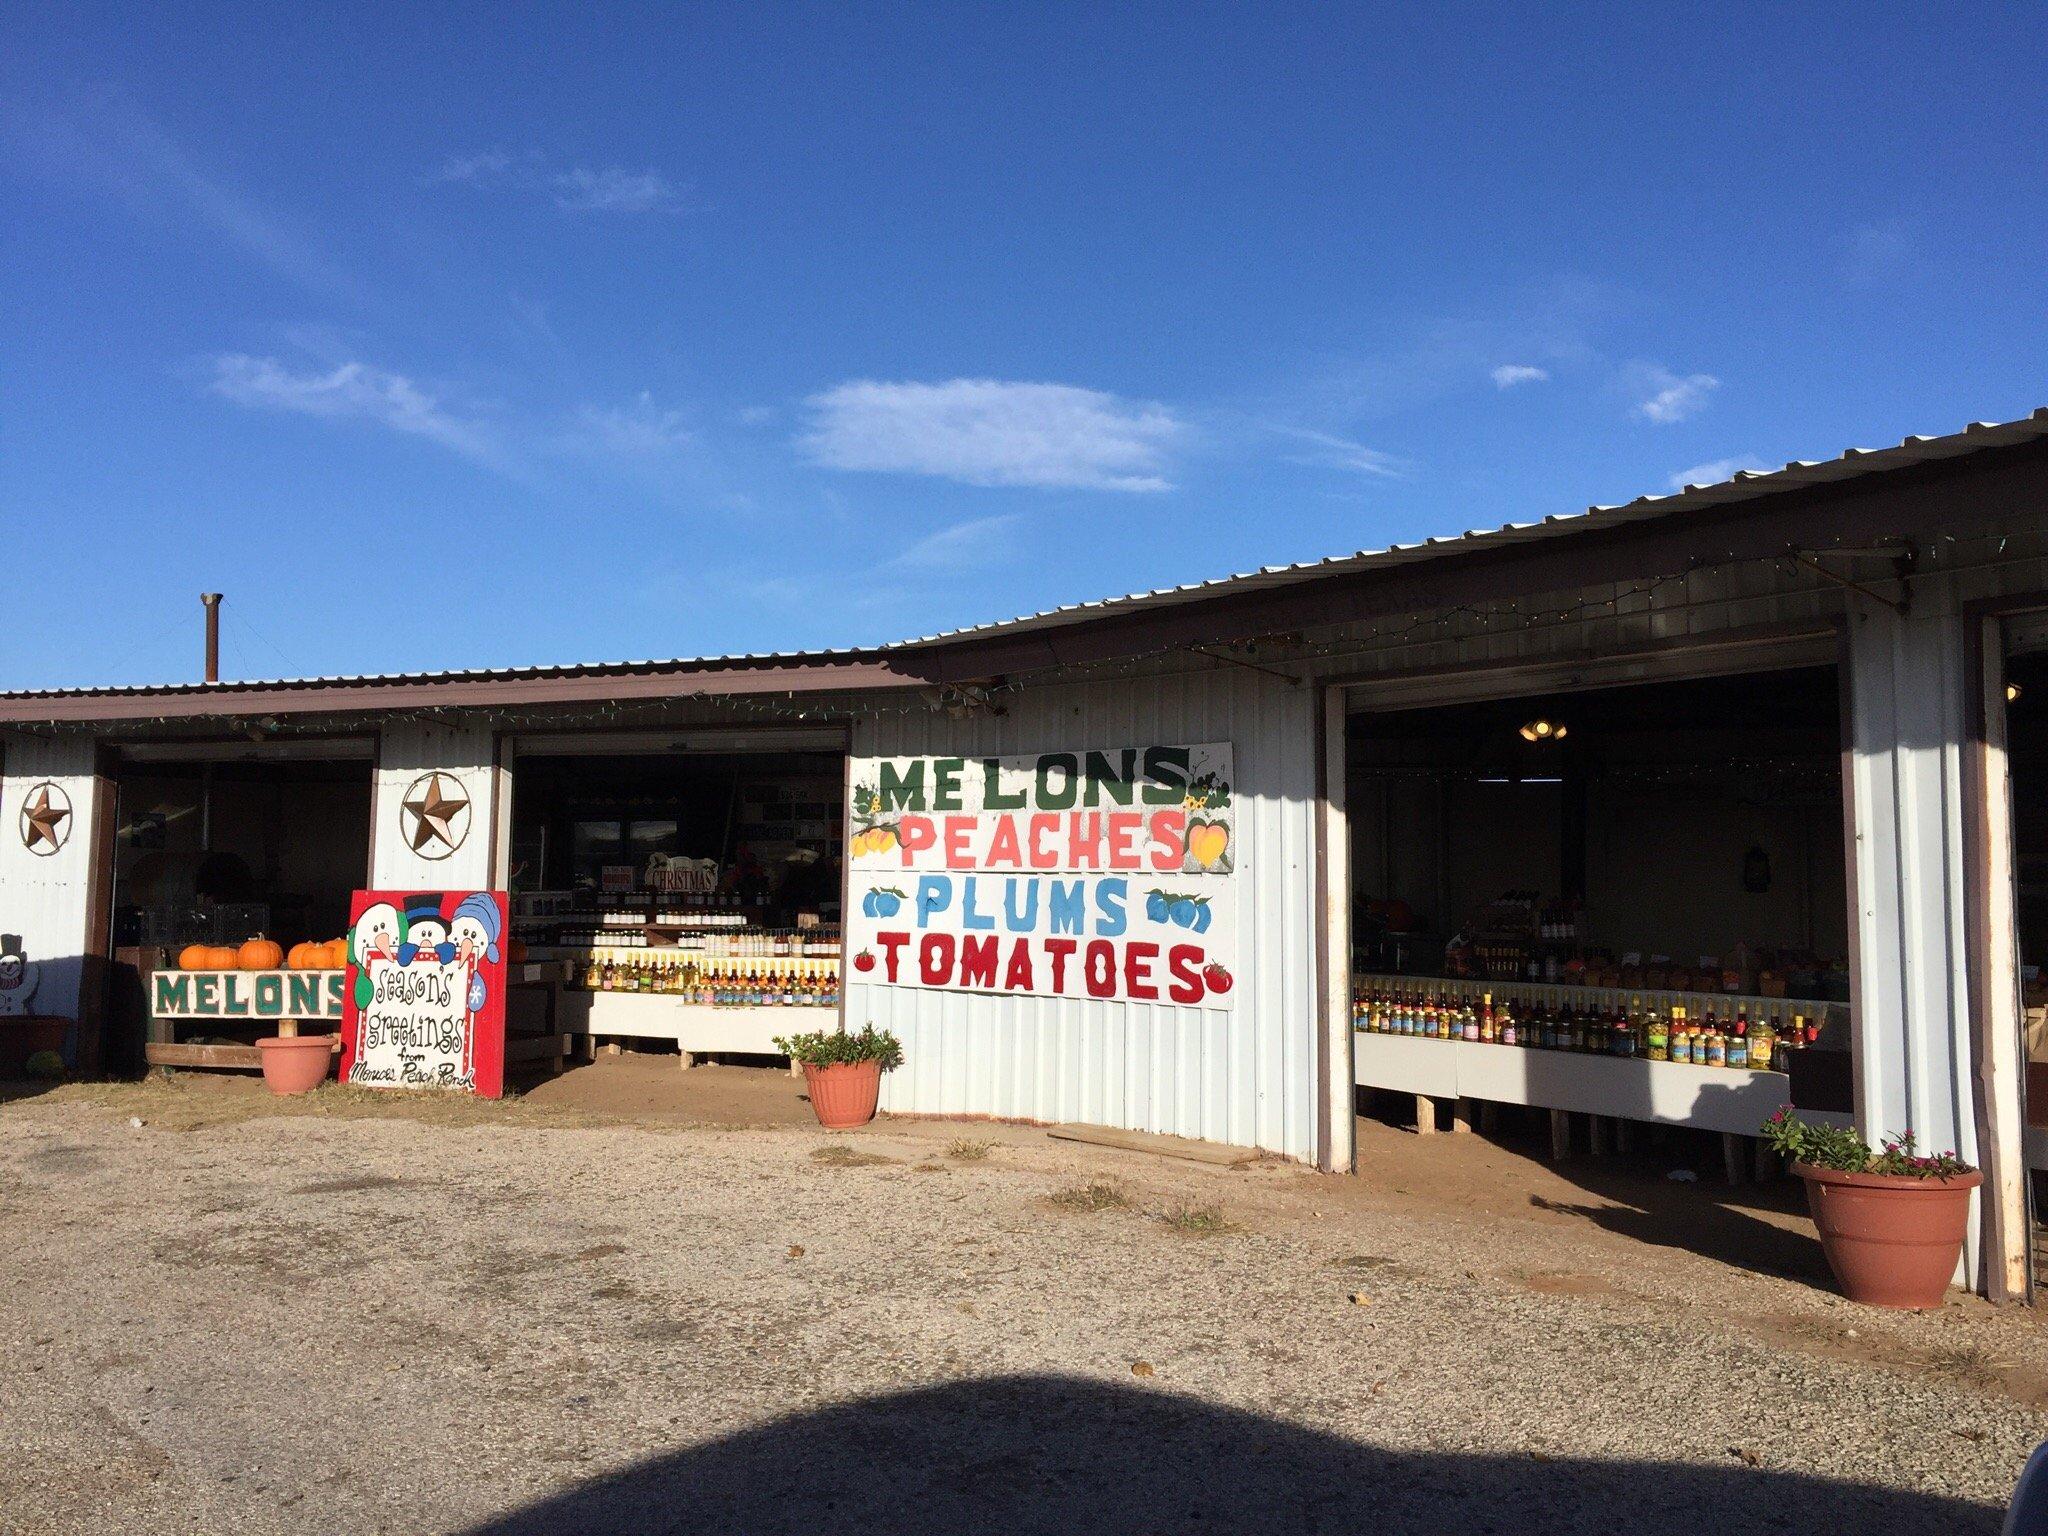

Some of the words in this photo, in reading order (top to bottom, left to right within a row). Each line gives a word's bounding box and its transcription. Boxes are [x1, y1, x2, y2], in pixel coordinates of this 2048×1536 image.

[879, 746, 1191, 812] MELONS
[900, 811, 1186, 870] PEACHES
[653, 870, 712, 890] CHRISTMAS
[915, 875, 1128, 936] PLUMS
[876, 931, 1205, 1004] TOMATOES
[155, 974, 346, 1017] MELONS
[366, 1011, 465, 1054] greetings
[398, 1047, 425, 1061] from
[400, 1062, 435, 1084] Peach
[437, 1063, 475, 1088] Ranch
